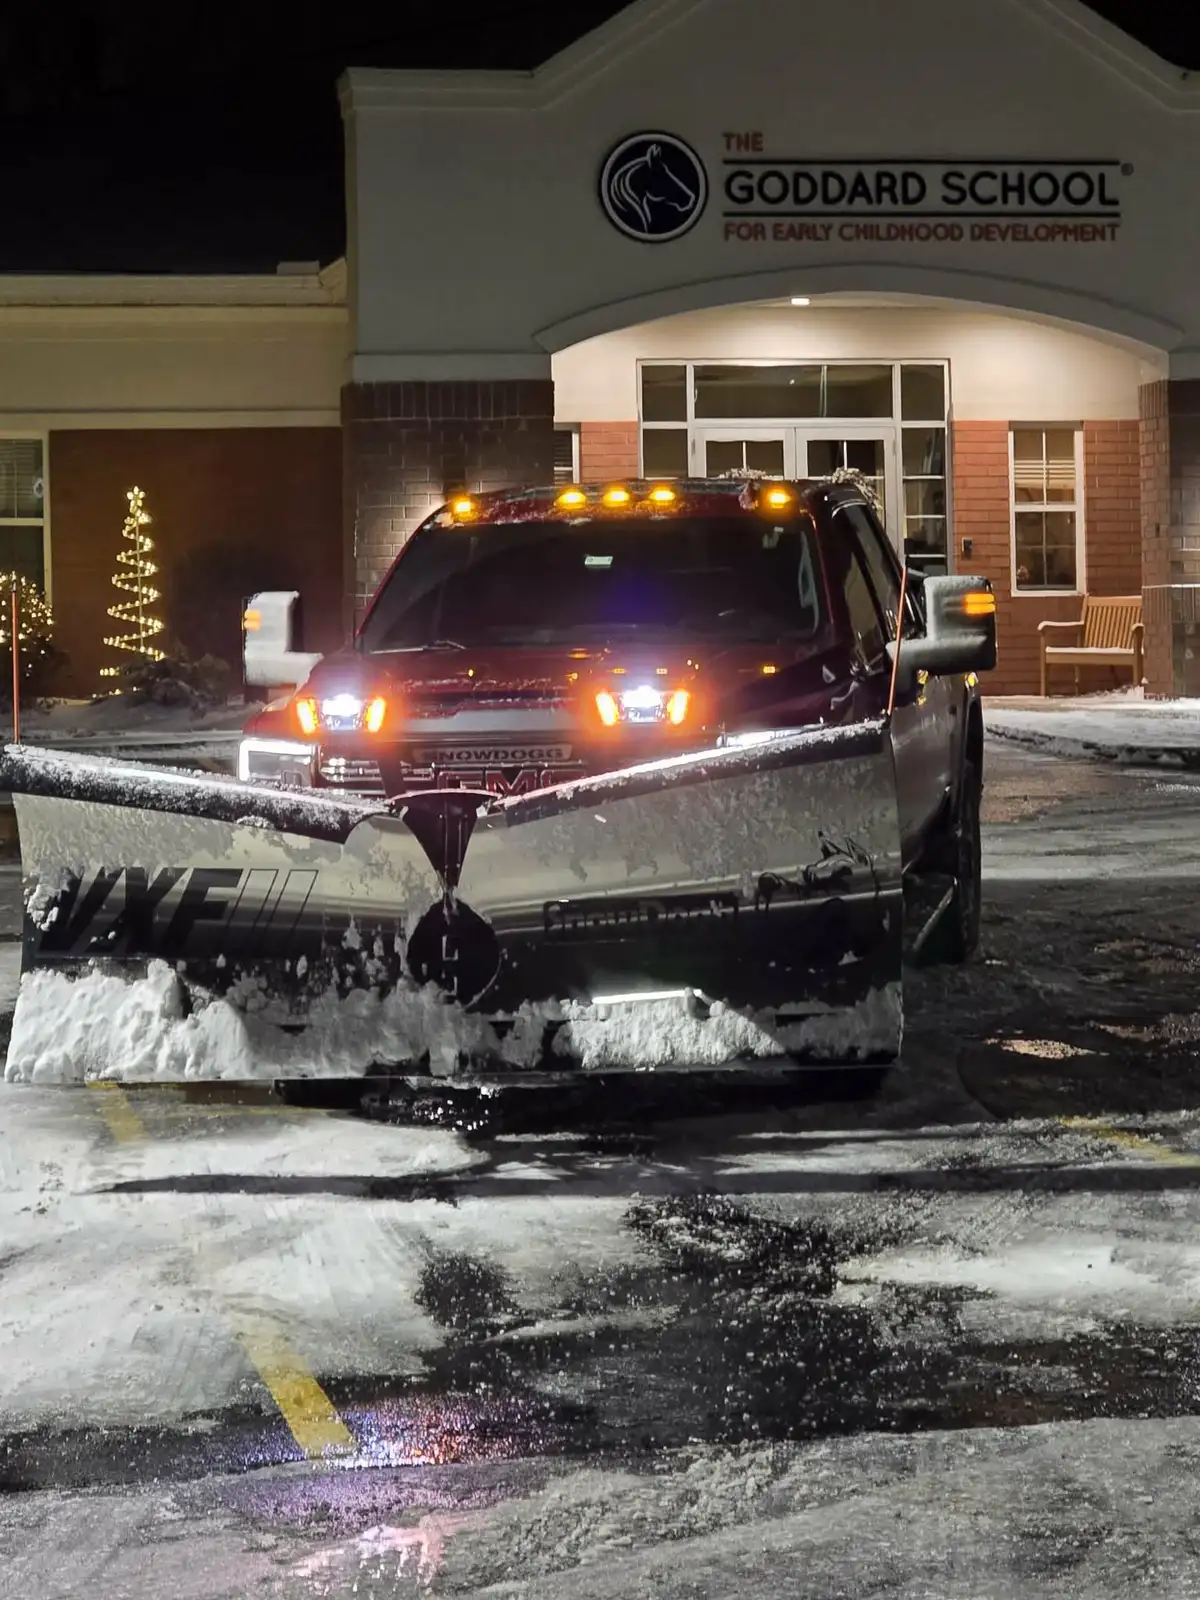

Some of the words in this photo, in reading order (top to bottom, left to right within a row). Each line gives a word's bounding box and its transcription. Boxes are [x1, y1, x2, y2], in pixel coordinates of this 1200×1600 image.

[724, 132, 763, 152] THE
[724, 170, 927, 206] GODDARD
[941, 170, 1120, 206] SCHOOL
[724, 223, 766, 242] FOR
[773, 223, 832, 242] EARLY
[839, 223, 964, 242] CHILDHOOD
[971, 223, 1119, 242] DEVELOPMENT
[419, 745, 563, 762] NOWDOGG
